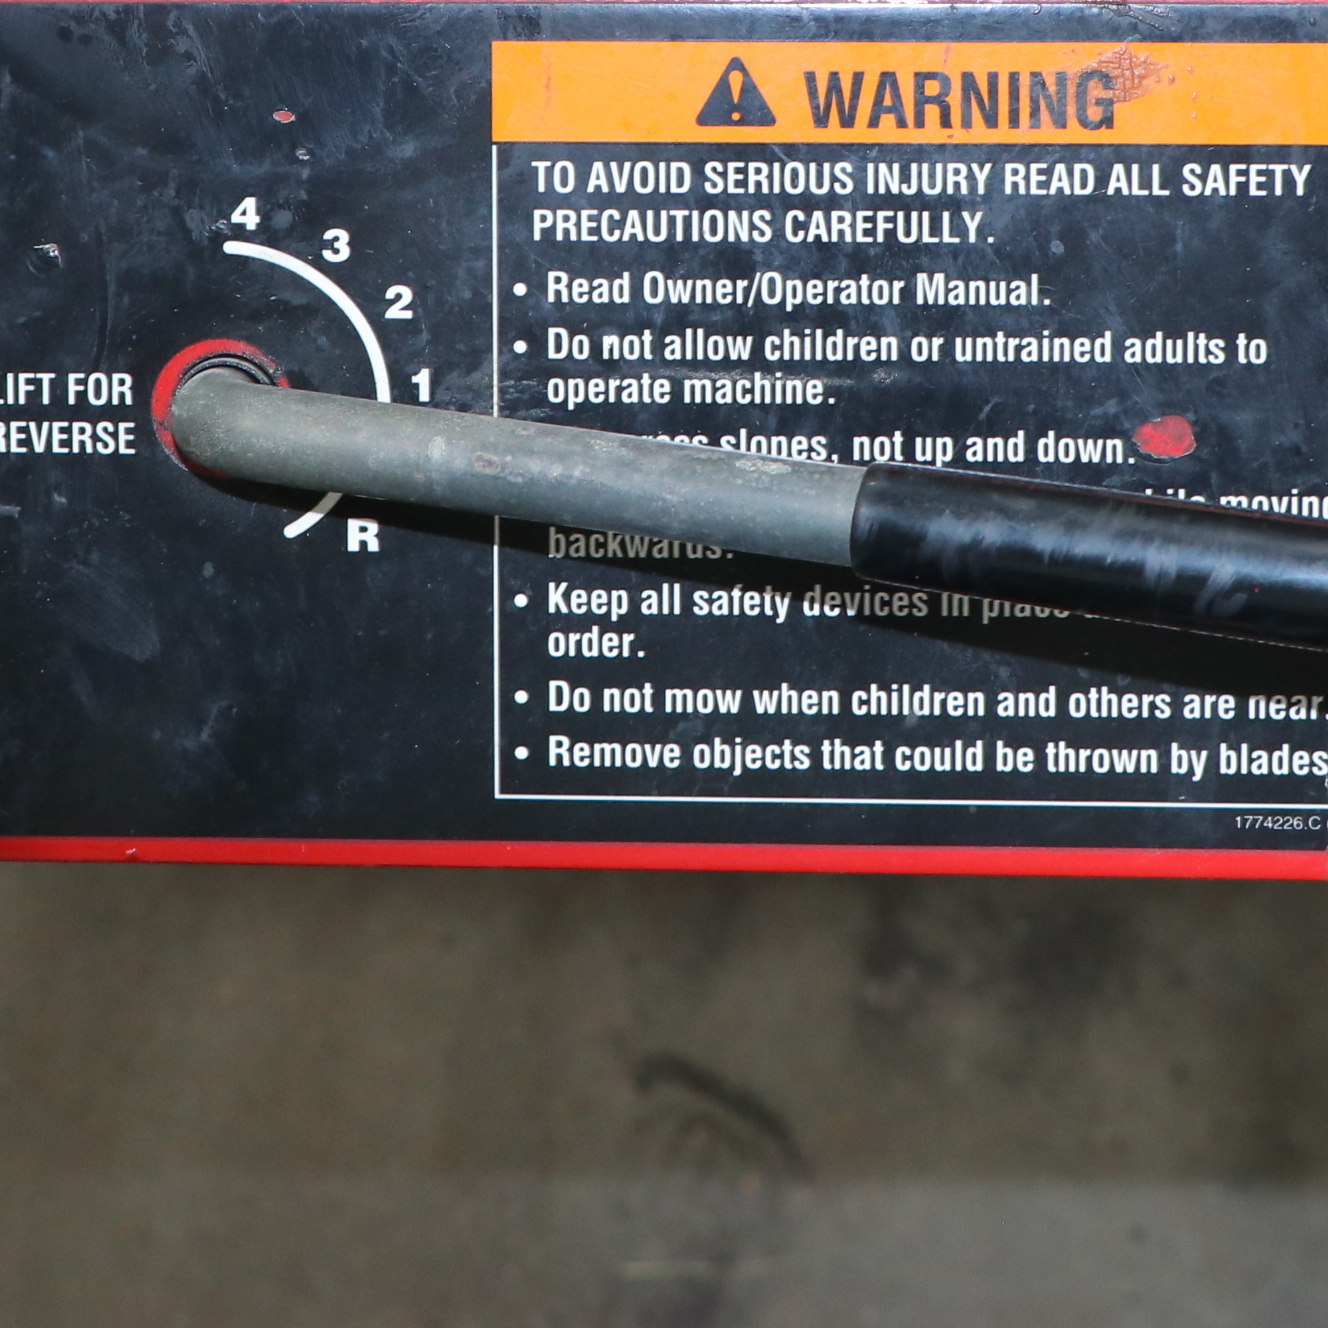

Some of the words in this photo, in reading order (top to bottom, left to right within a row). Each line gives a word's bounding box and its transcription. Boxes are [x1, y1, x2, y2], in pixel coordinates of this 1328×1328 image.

[805, 70, 1114, 130] WARNING
[531, 159, 576, 194] TO
[586, 160, 692, 195] AVOID
[703, 160, 855, 195] SERIOUS
[866, 162, 993, 196] INJURY
[1003, 162, 1096, 196] READ
[1106, 162, 1171, 196] ALL
[1181, 162, 1312, 197] SAFETY
[230, 196, 261, 231] 4
[533, 208, 773, 243] PRECAUTIONS
[784, 209, 995, 244] CAREFULLY.
[321, 228, 351, 263] 3
[384, 284, 414, 320] 2
[547, 270, 631, 304] Read
[643, 270, 906, 312] Owner/Operator
[916, 272, 1051, 307] Manual.
[547, 326, 590, 360] Do
[602, 328, 654, 361] not
[663, 327, 754, 361] allow
[764, 328, 899, 362] children
[910, 335, 945, 362] or
[954, 329, 1112, 363] untrained
[1123, 330, 1226, 365] adults
[1235, 332, 1268, 365] to
[68, 372, 133, 406] FOR
[411, 367, 431, 403] 1
[547, 372, 672, 411] operate
[683, 370, 836, 405] machine.
[852, 430, 904, 462] not
[913, 436, 954, 467] up
[965, 429, 1025, 463] and
[1037, 430, 1136, 465] down.
[347, 518, 380, 552] R
[548, 581, 629, 622] Keep
[640, 582, 681, 615] all
[692, 584, 790, 624] safety
[802, 584, 928, 617] devices
[547, 625, 645, 658] order.
[548, 680, 591, 713] Do
[603, 682, 654, 713] not
[665, 688, 743, 714] mow
[752, 682, 840, 715] when
[851, 683, 985, 717] children
[996, 685, 1057, 718] and
[1068, 685, 1172, 719] others
[1182, 693, 1236, 720] are
[548, 734, 681, 769] Remove
[693, 736, 811, 777] objects
[820, 738, 885, 771] that
[894, 739, 984, 772] could
[996, 739, 1035, 773] be
[1045, 740, 1158, 774] thrown
[1170, 741, 1209, 782] by
[1234, 815, 1322, 831] 1774226.C
